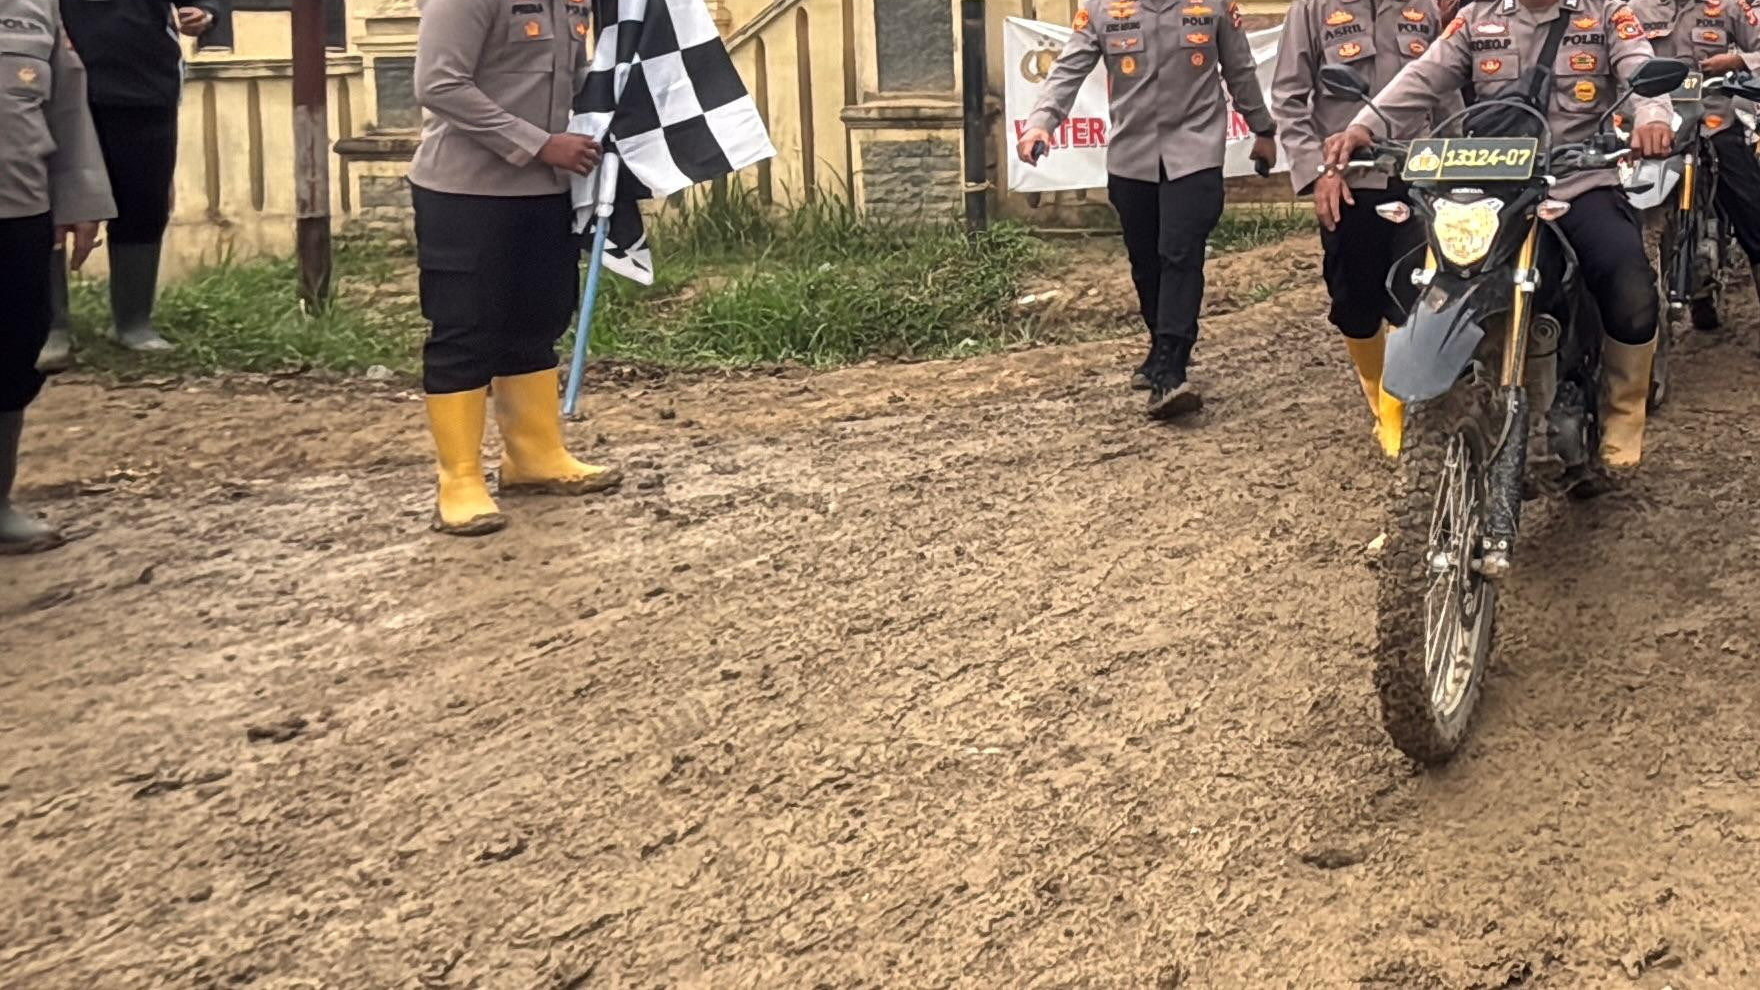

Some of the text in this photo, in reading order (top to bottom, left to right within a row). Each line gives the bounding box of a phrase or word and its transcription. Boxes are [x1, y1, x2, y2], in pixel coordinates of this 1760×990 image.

[1324, 23, 1365, 41] ASRIL
[1562, 33, 1605, 46] POLRI
[1443, 148, 1531, 167] 13124-07
